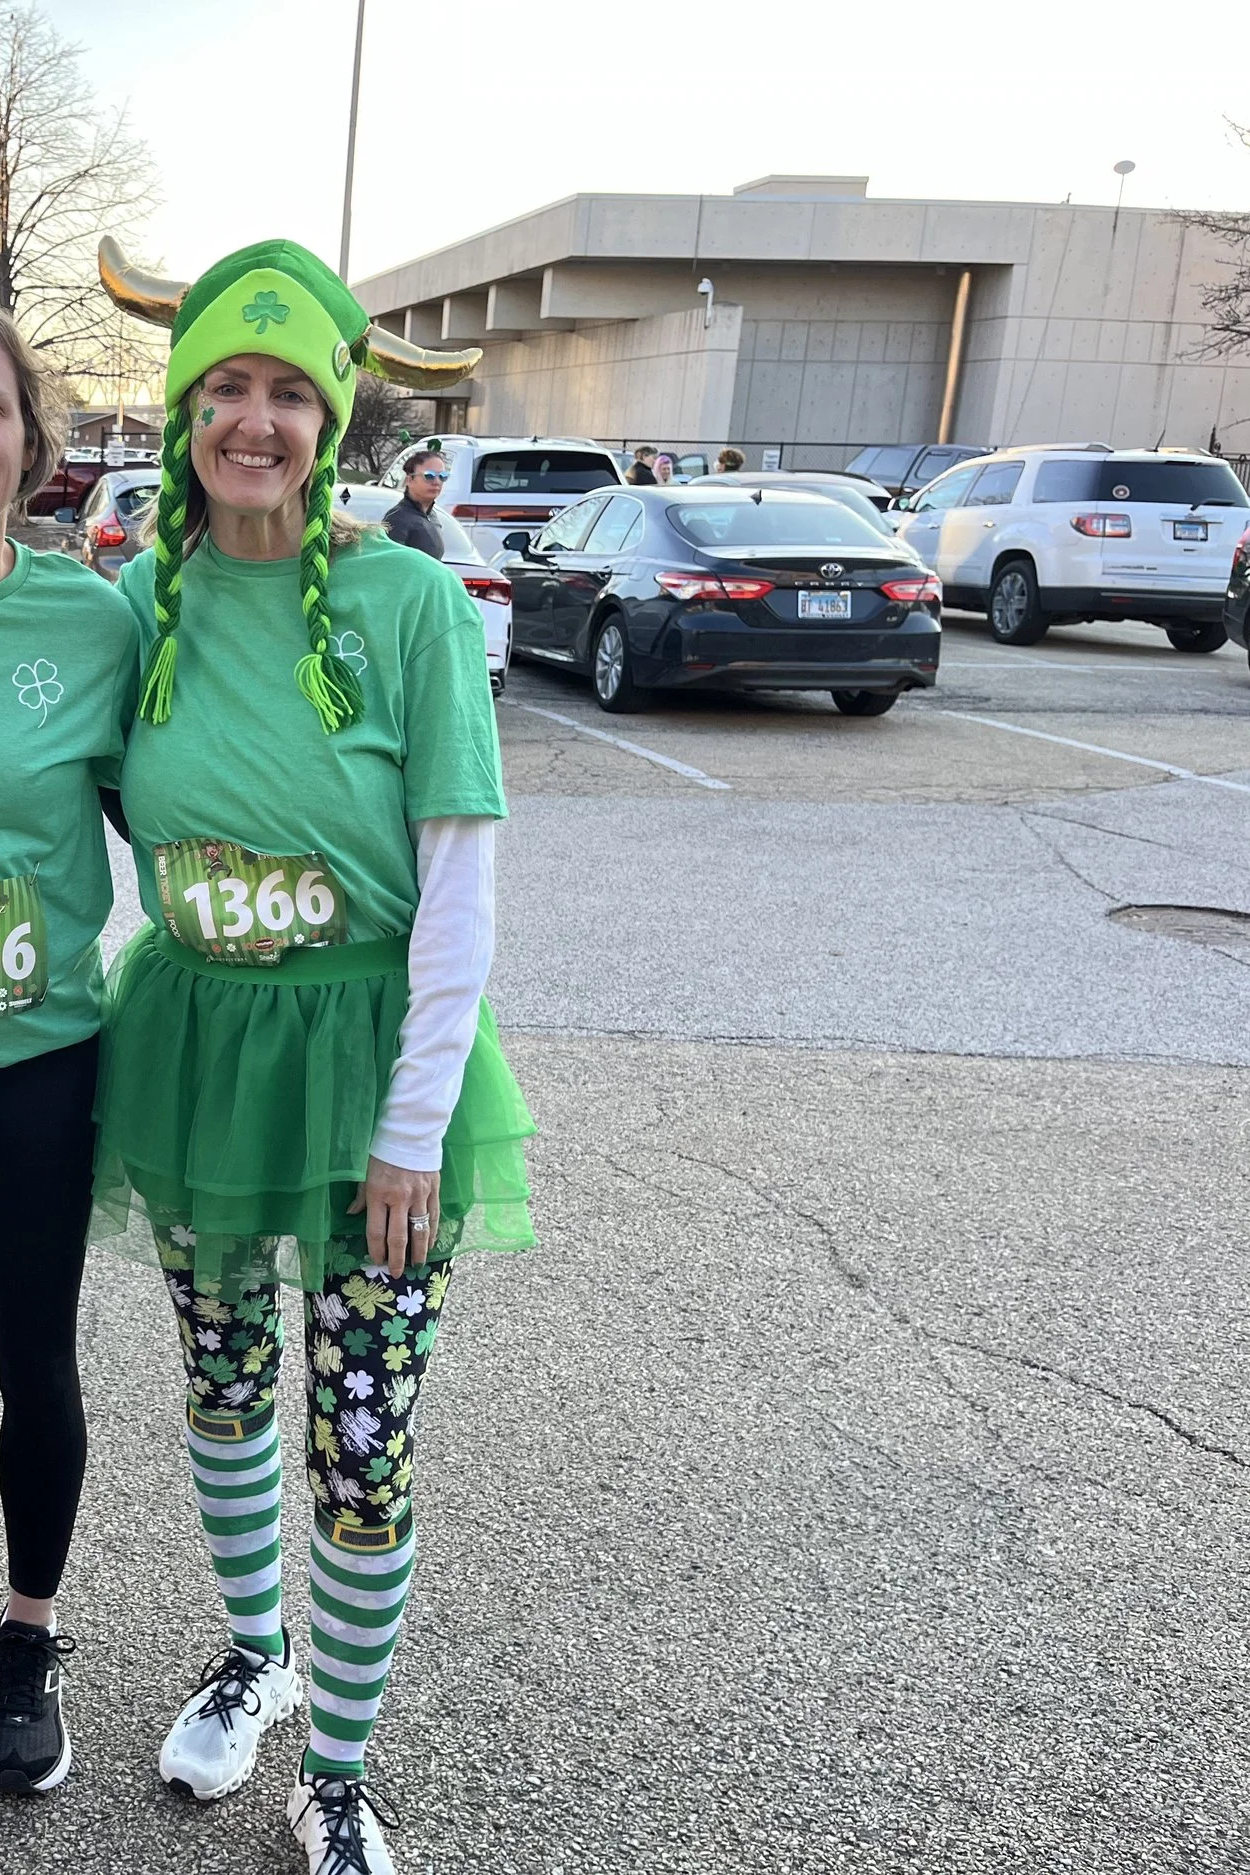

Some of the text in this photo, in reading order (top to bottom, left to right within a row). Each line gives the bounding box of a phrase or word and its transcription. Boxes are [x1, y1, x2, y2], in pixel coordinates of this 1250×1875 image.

[158, 855, 167, 876] BEER
[183, 869, 335, 940] 1366
[168, 919, 181, 938] FOOD
